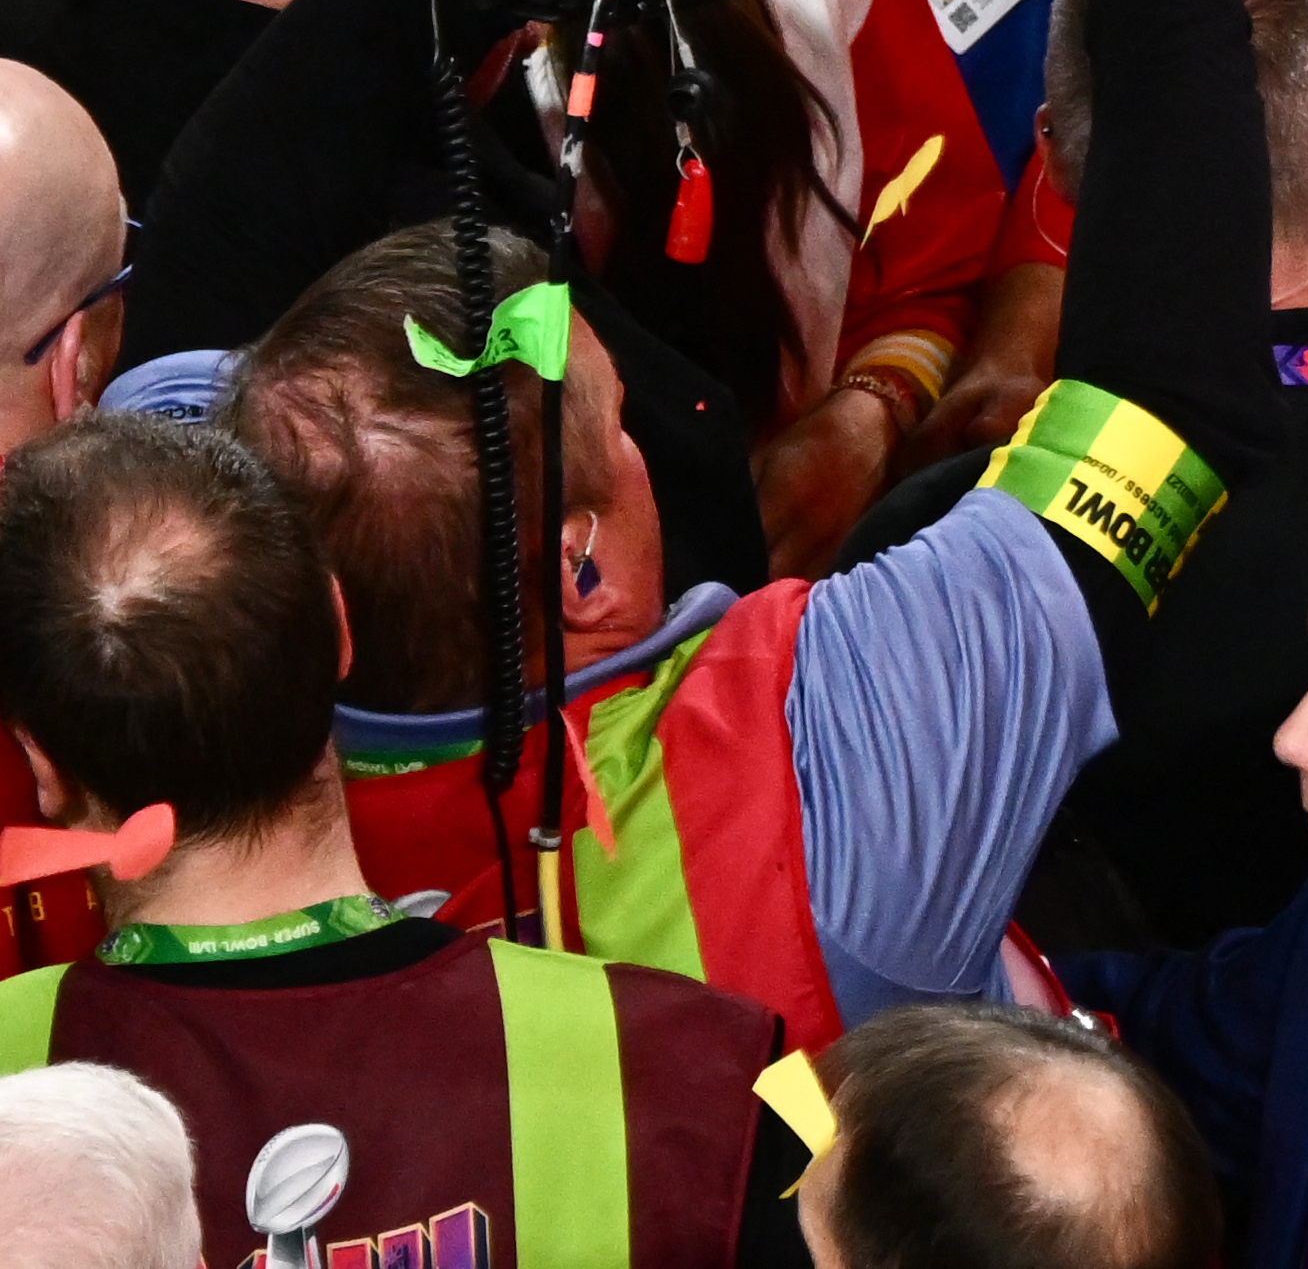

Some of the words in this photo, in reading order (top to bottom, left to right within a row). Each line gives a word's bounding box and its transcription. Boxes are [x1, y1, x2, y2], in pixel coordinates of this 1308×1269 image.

[1124, 480, 1172, 529] Access
[1065, 477, 1153, 566] BOWL
[222, 934, 268, 953] BOWL
[275, 921, 320, 944] SUPER
[188, 940, 217, 954] LVIII
